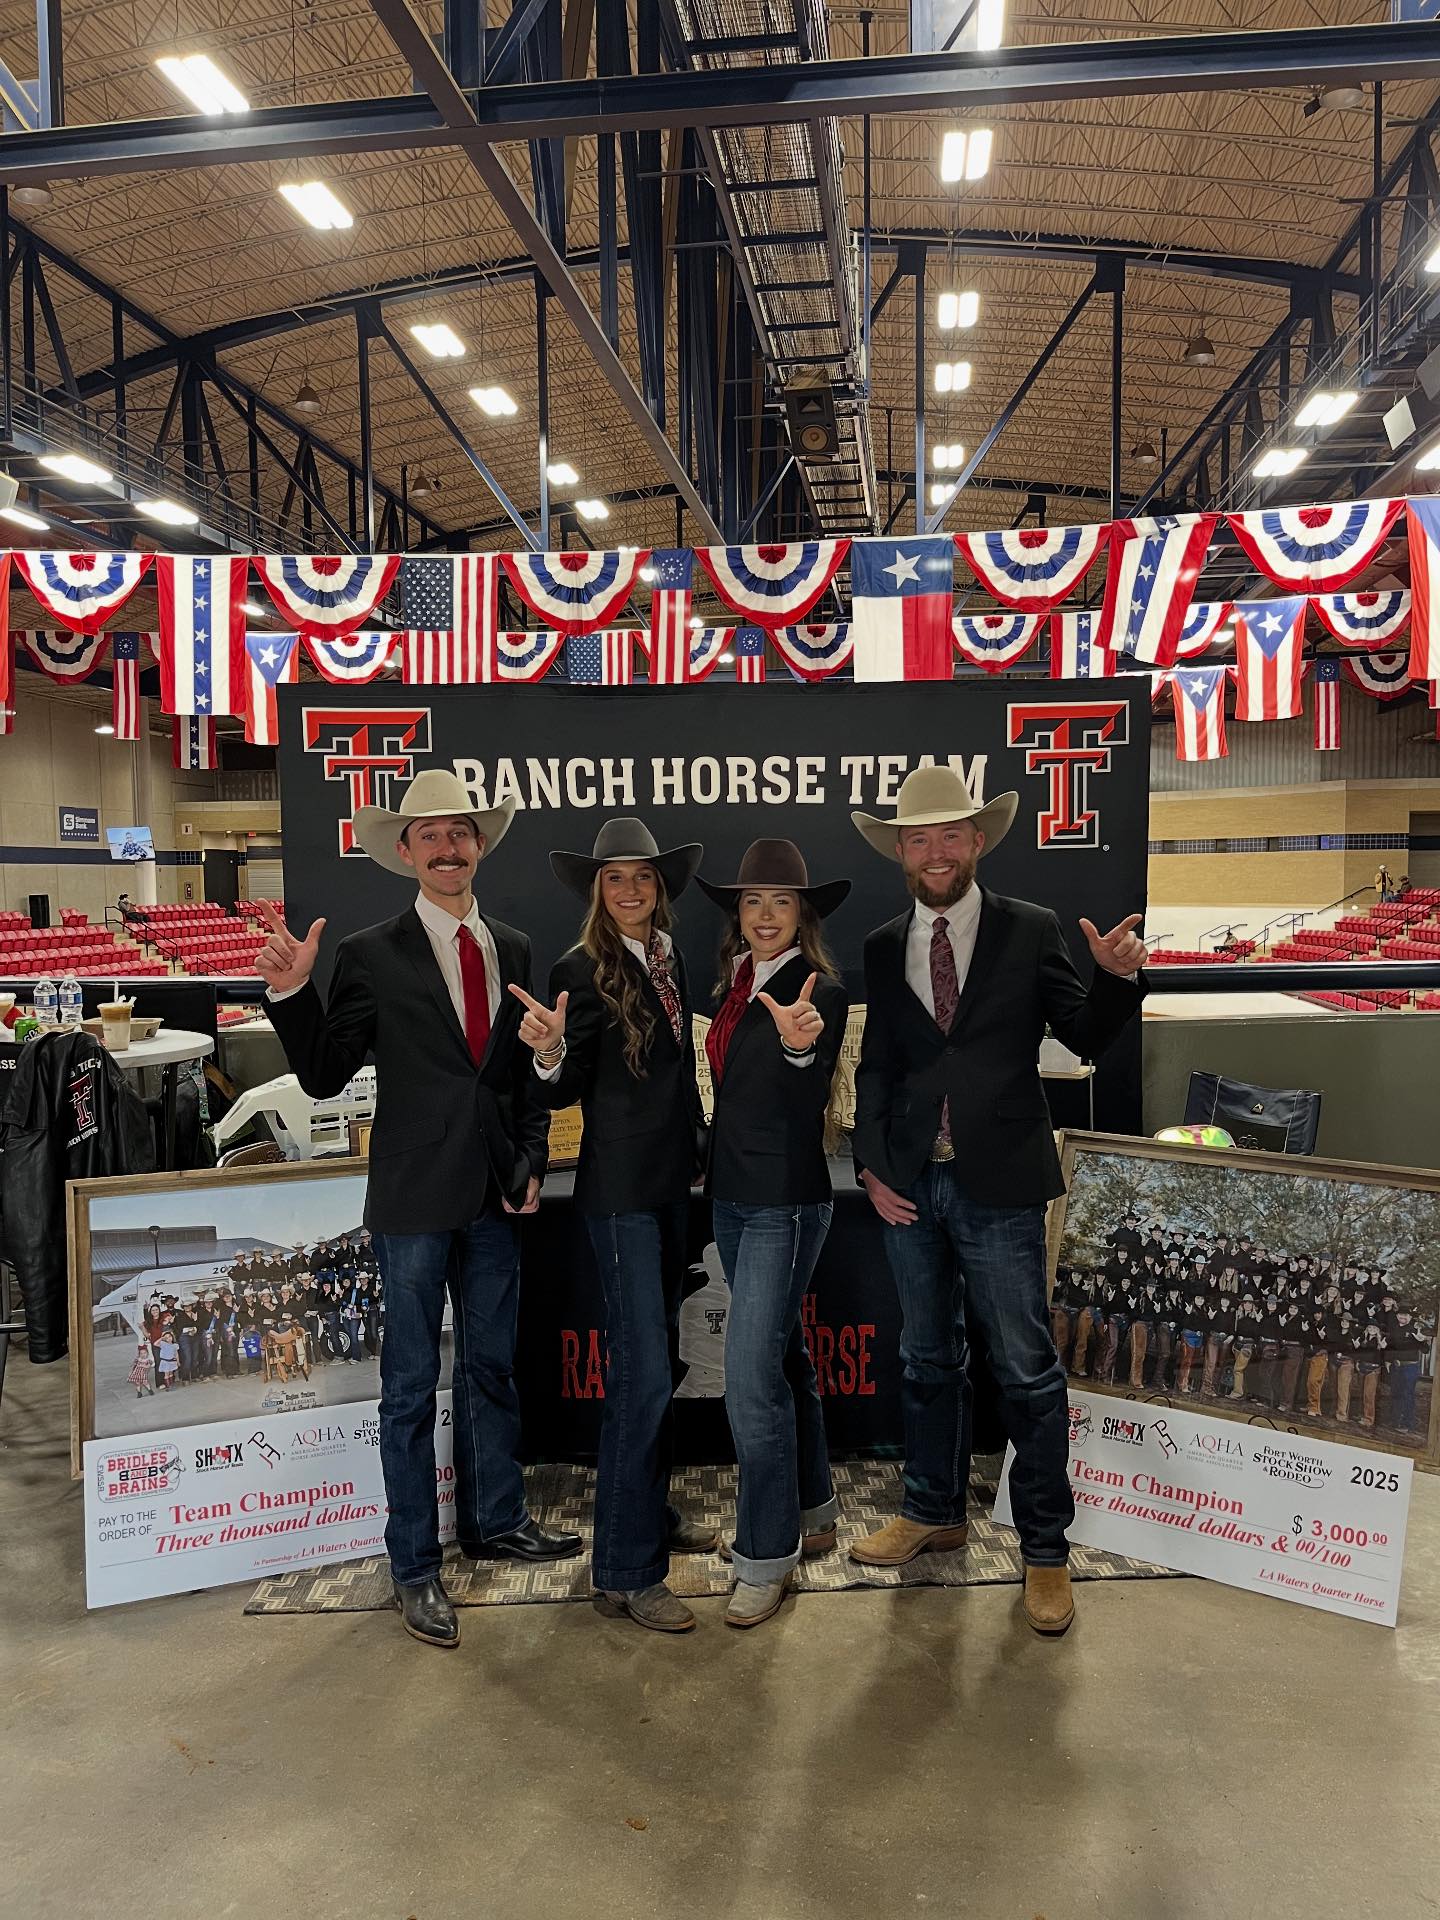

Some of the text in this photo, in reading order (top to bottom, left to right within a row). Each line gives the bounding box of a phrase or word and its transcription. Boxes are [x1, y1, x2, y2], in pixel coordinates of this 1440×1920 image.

[452, 755, 988, 810] RANCH HORSE TEM
[362, 1419, 380, 1428] FOR
[291, 1426, 346, 1447] AQHA
[1189, 1433, 1243, 1456] AQHA
[291, 1447, 320, 1455] AMERICAN
[310, 1449, 346, 1457] ASSOCIATION
[1188, 1450, 1243, 1465] AMERICAN QUARTER
[1263, 1445, 1323, 1467] FORT WORTH
[107, 1452, 167, 1472] BRIDLES
[1206, 1460, 1243, 1470] ASSOCIATION
[1252, 1453, 1333, 1478] STOCK SHOW
[130, 1470, 147, 1478] AND
[1269, 1466, 1312, 1484] RODEO
[1350, 1466, 1399, 1492] 2025
[108, 1476, 168, 1496] BRAINS
[1072, 1459, 1243, 1516] Team Champion
[169, 1480, 354, 1525] Team Champion
[99, 1510, 157, 1527] PAY TO THE
[155, 1503, 379, 1554] Three thousand dollars
[1292, 1514, 1303, 1536] $
[99, 1525, 153, 1542] ORDER OF
[1107, 1497, 1195, 1529] thousand
[1198, 1518, 1266, 1547] dollars
[1271, 1535, 1289, 1553] &
[1295, 1539, 1351, 1568] 00/100
[301, 1547, 315, 1558] LA
[317, 1542, 347, 1554] Waters
[350, 1537, 385, 1550] Quarter
[1259, 1568, 1385, 1608] LA Waters Quarter Horse
